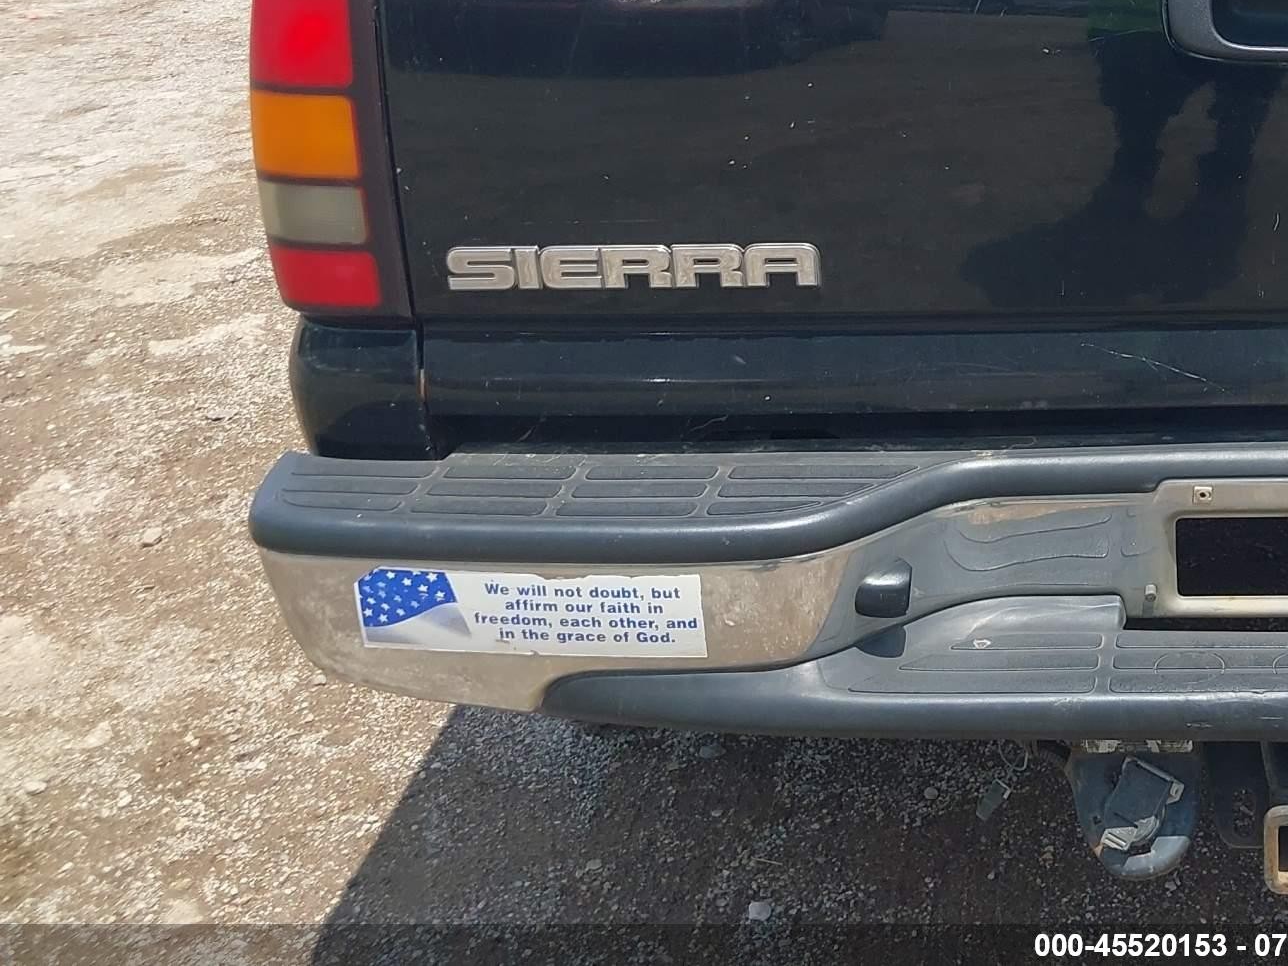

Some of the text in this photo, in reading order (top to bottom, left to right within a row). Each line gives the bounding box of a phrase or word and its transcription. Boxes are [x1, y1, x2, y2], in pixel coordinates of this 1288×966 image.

[446, 243, 822, 290] SIERRA
[484, 582, 681, 601] We will not doubt, but
[505, 599, 664, 614] affirm our faith in
[474, 612, 698, 630] freedom, each other, and
[499, 627, 676, 644] in the grace of God.
